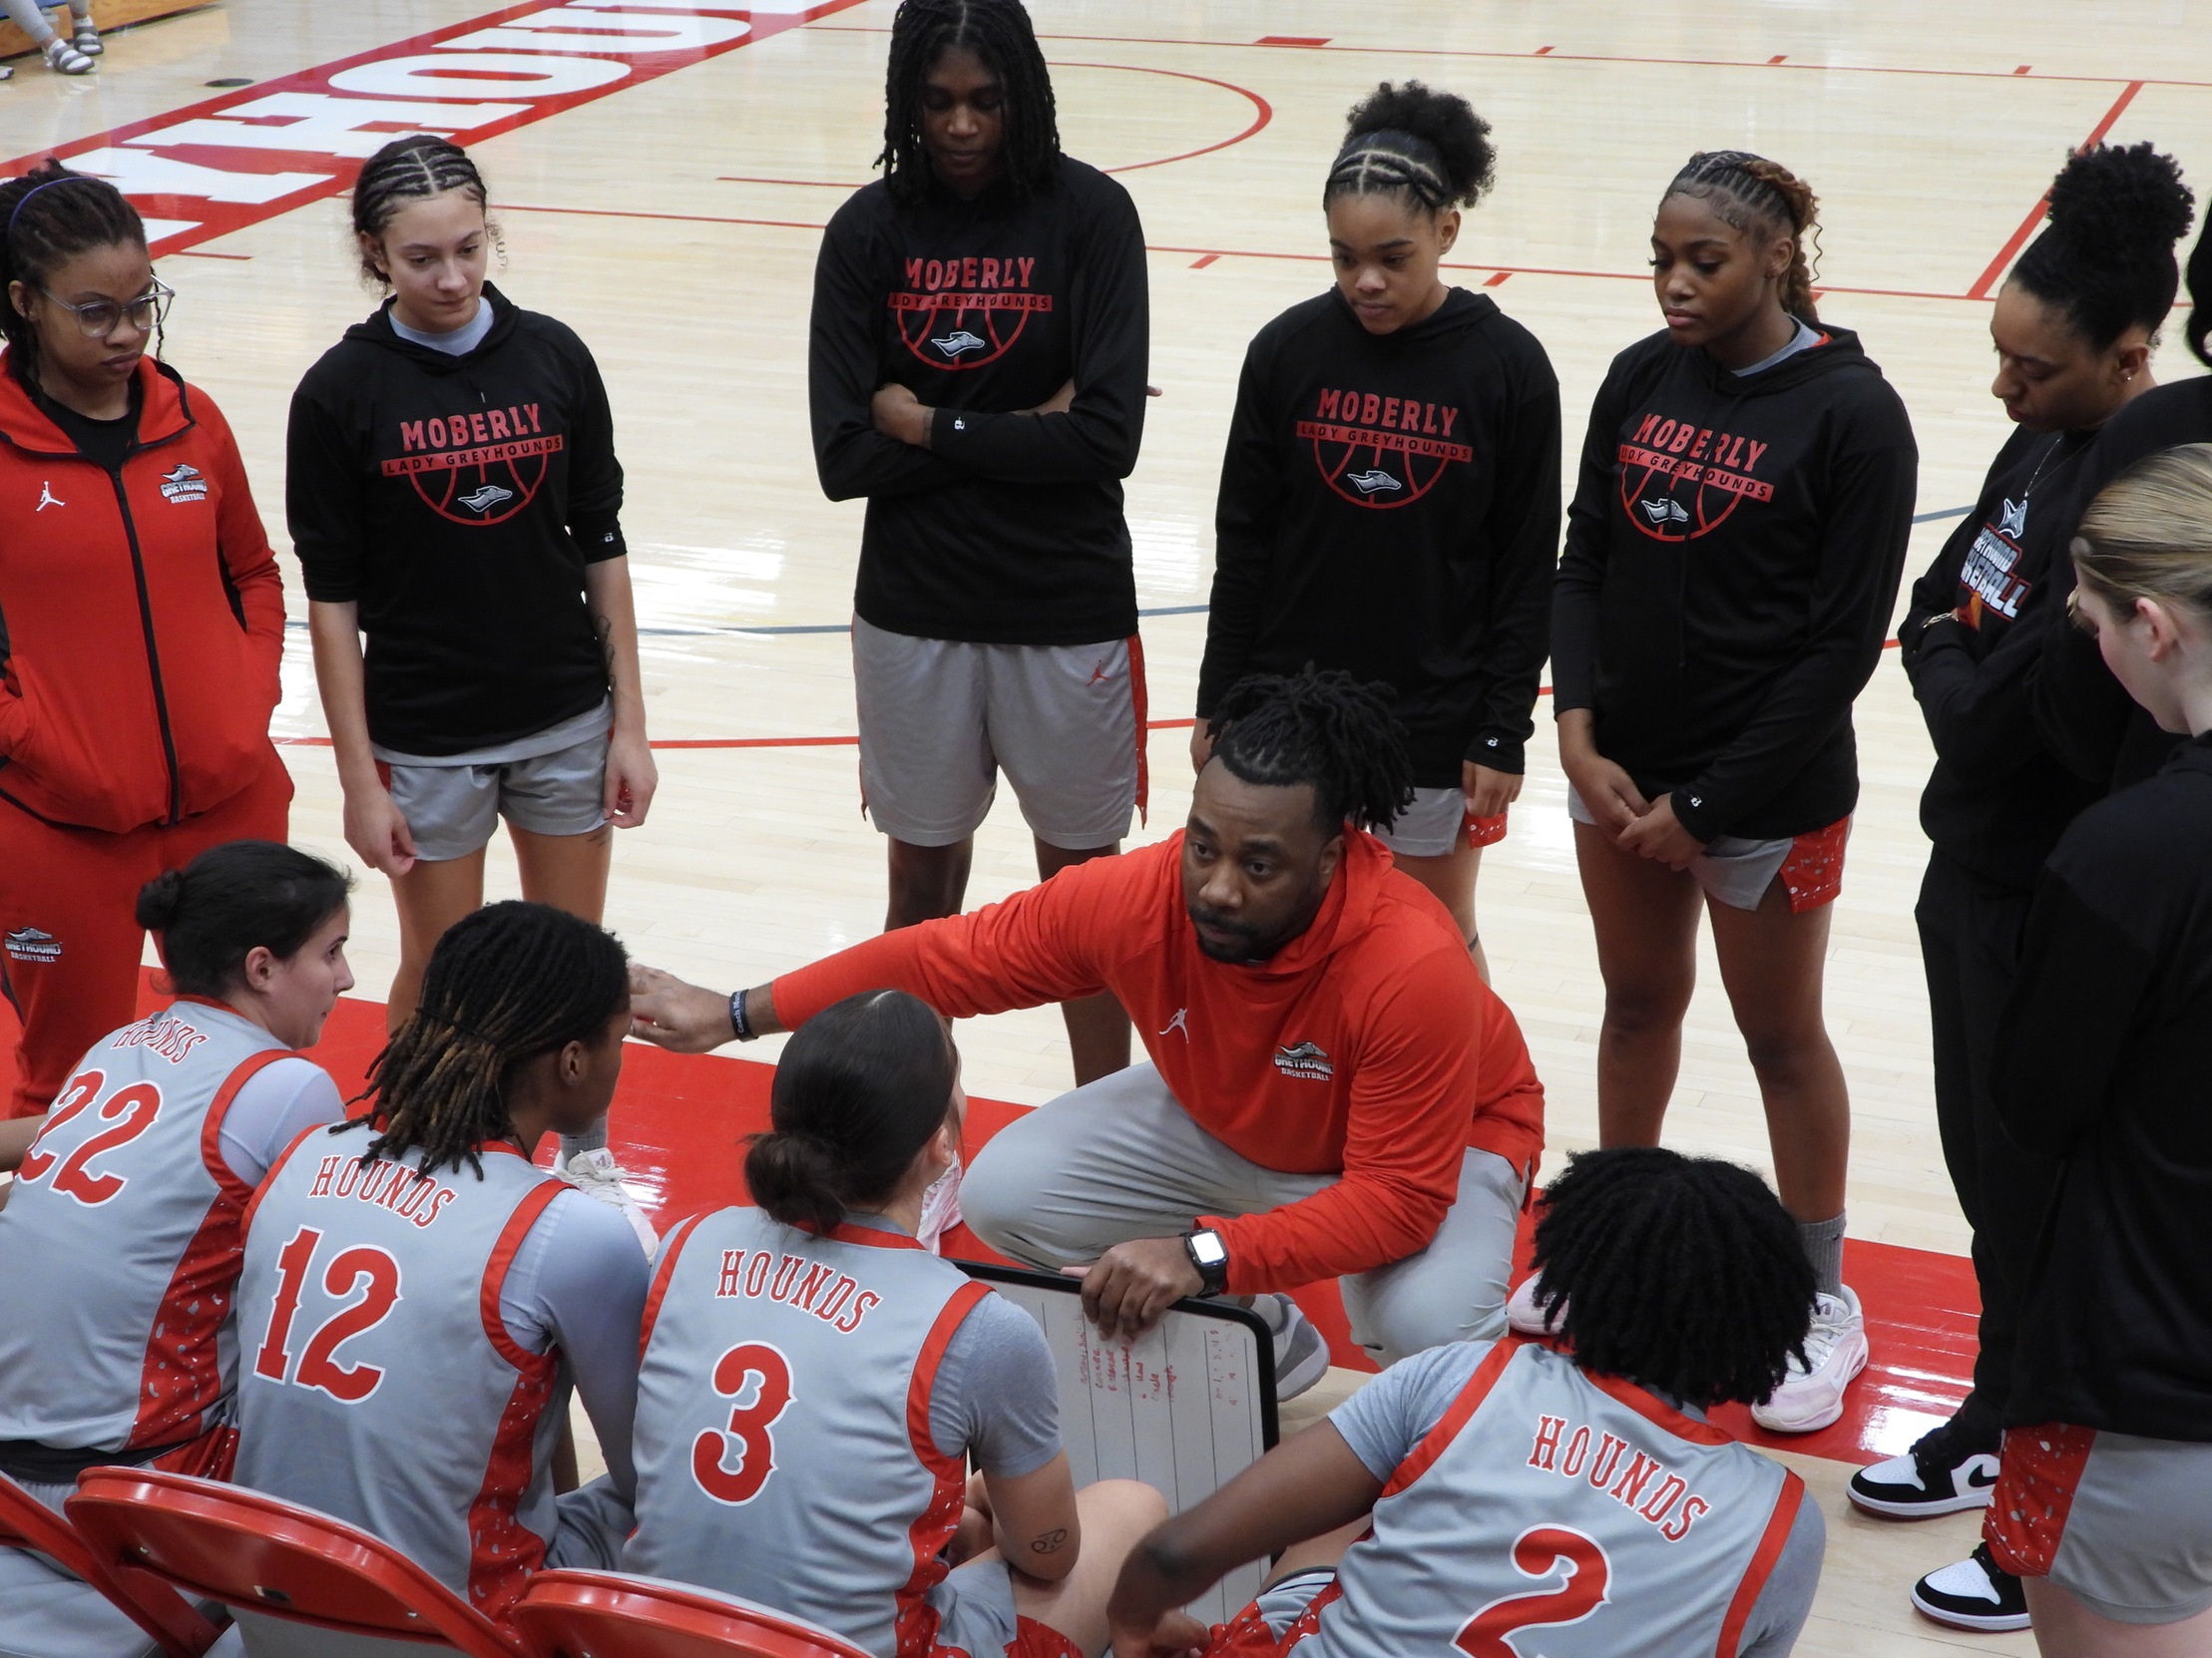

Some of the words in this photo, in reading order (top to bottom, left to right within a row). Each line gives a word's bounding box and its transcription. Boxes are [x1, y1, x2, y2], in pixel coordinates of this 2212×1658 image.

[905, 256, 1035, 291] MOBERLY
[893, 295, 922, 307] LDY
[400, 402, 542, 452] MOBERLY
[1316, 387, 1459, 437] MOBERLY
[387, 457, 434, 473] LADY
[446, 437, 561, 465] GREYHOUNDS
[1301, 424, 1339, 438] LADY
[1348, 430, 1469, 459] GREYHOUNDS
[1632, 413, 1768, 472] MOBERLY
[110, 1017, 211, 1064] HOUNDS
[1281, 1066, 1330, 1081] BASKETBALL
[17, 1068, 163, 1207] 22
[307, 1154, 457, 1229] HOUNDS
[253, 1224, 403, 1405] 12
[714, 1247, 884, 1335] HOUNDS
[690, 1340, 798, 1506] 3
[1526, 1413, 1713, 1543] HOUNDS
[1450, 1522, 1612, 1658] 2
